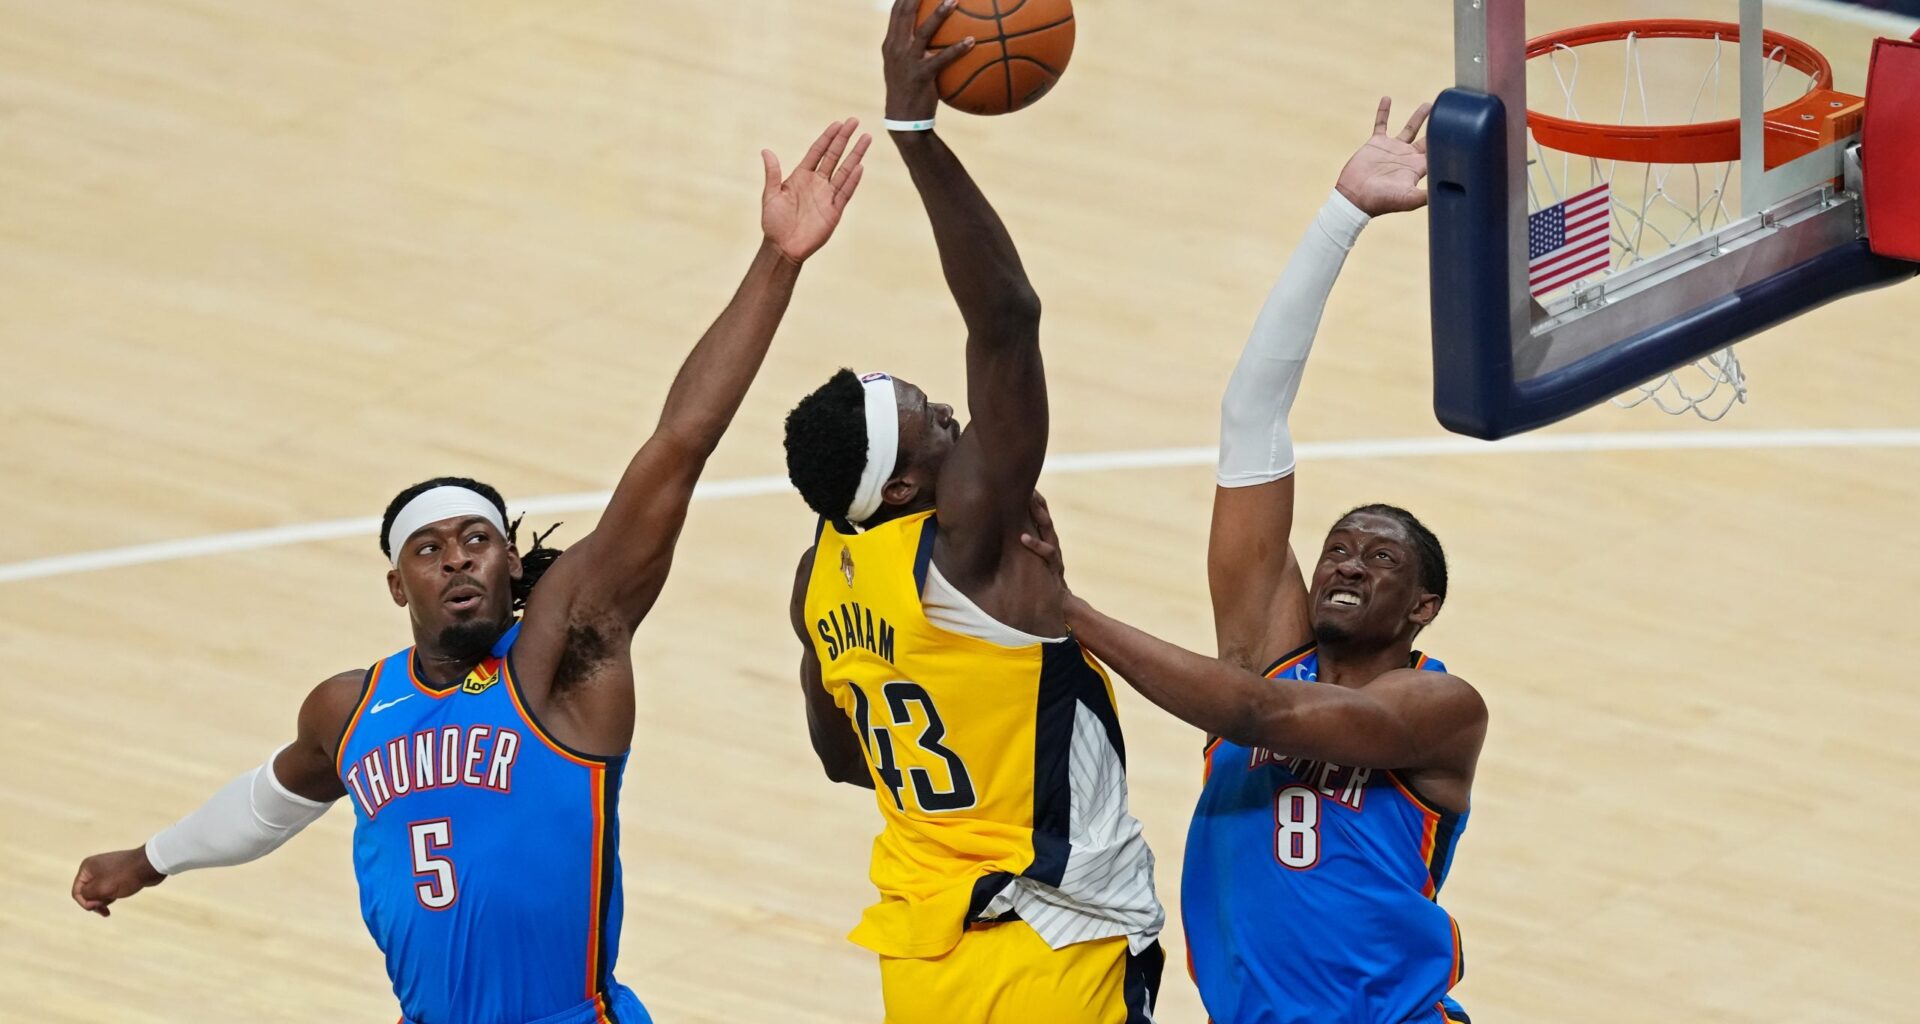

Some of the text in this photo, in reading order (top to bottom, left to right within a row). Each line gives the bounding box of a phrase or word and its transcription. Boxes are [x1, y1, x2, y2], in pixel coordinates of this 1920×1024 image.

[817, 602, 895, 665] SIAKAM
[347, 724, 520, 820] THUNDER
[848, 681, 977, 813] 43
[408, 817, 458, 911] 5
[1273, 784, 1321, 871] 8
